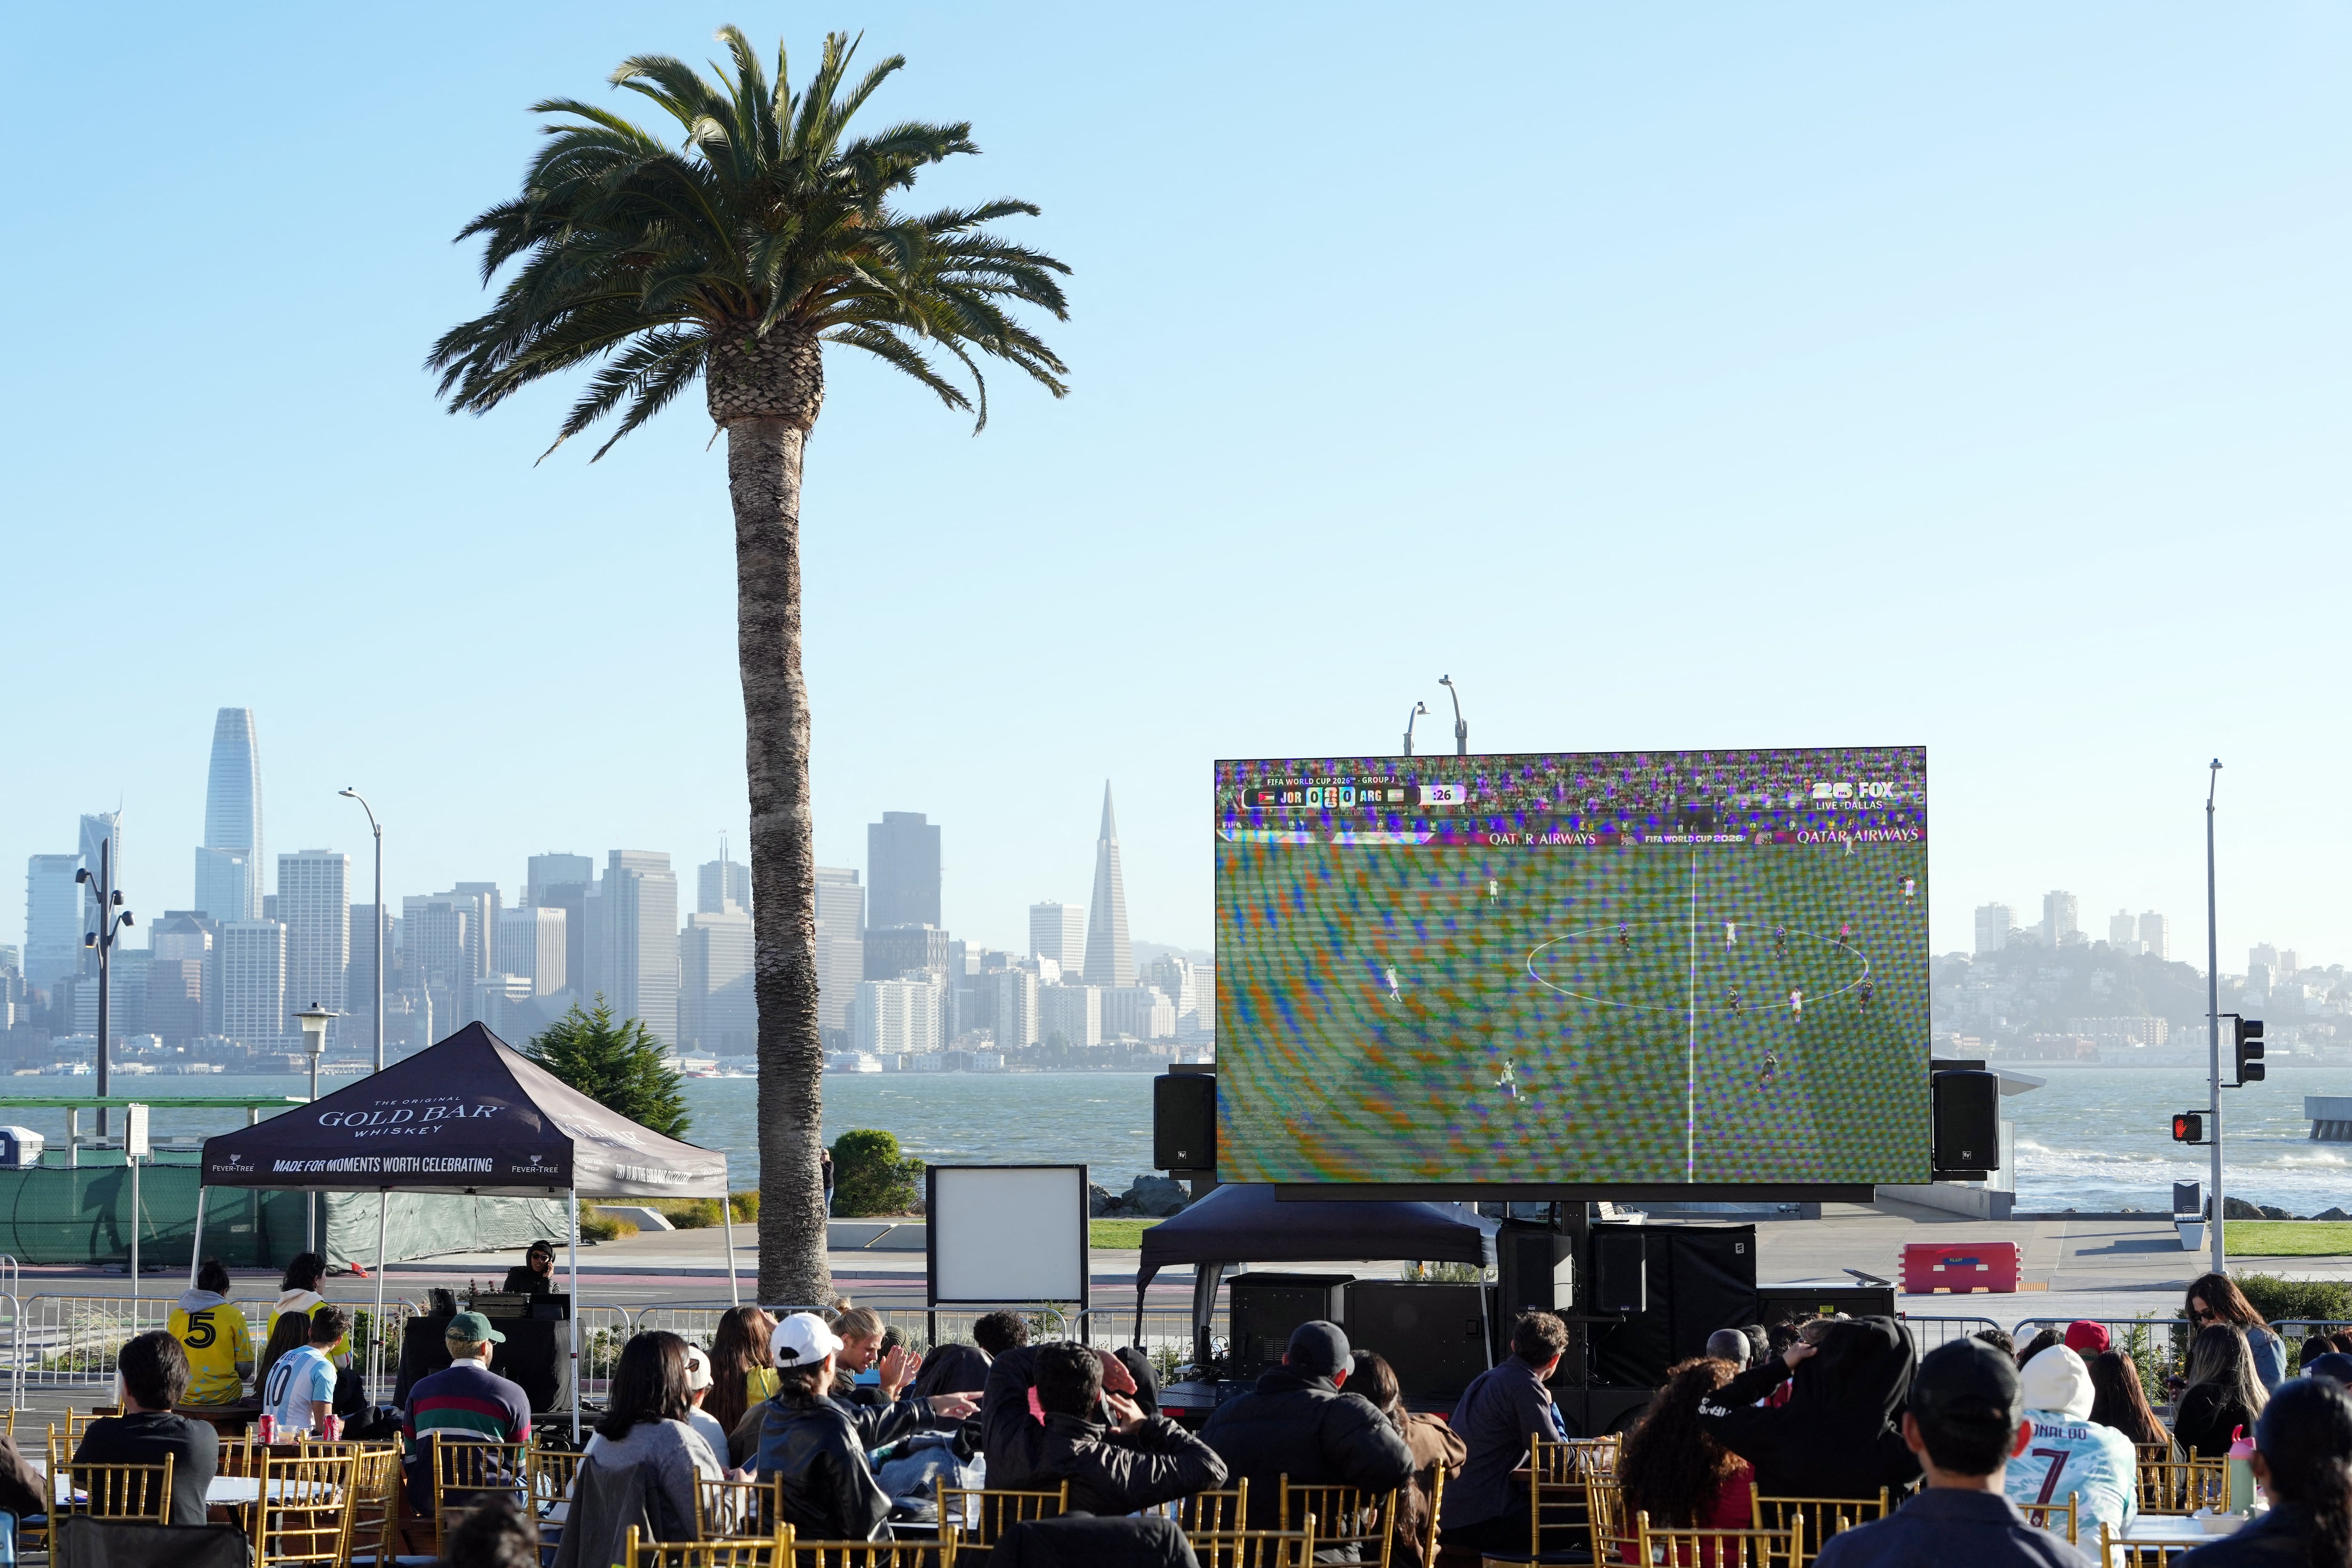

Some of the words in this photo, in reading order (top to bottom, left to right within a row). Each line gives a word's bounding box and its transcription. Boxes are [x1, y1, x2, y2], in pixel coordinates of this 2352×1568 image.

[1280, 792, 1302, 804] JOR
[1311, 791, 1319, 804] 0
[1343, 791, 1351, 804] 0
[1359, 790, 1382, 802] ARG
[1433, 790, 1451, 801] :26
[1859, 782, 1894, 798] FOX
[1816, 801, 1838, 810] LIVE
[1844, 801, 1883, 810] DALLAS
[1489, 833, 1534, 846] QATR
[1539, 833, 1596, 845] AIRWAYS
[1797, 830, 1847, 844] QATAR
[1854, 828, 1919, 843] AIRWAYS
[402, 1096, 461, 1105] ORIGINAL
[318, 1109, 413, 1127] GOLD
[355, 1124, 443, 1138] WHISKEY
[555, 1121, 609, 1137] GOLD
[272, 1159, 306, 1172] MADE
[304, 1160, 326, 1171] FOR
[326, 1157, 381, 1172] MOMENTS
[383, 1157, 420, 1172] WORTH
[422, 1157, 493, 1172] CELEBRATING
[615, 1163, 625, 1179] TRY
[626, 1165, 632, 1180] IT
[631, 1166, 638, 1181] AT
[637, 1167, 646, 1182] THE
[646, 1168, 658, 1184] GOLD
[657, 1169, 668, 1184] BAR
[184, 1312, 216, 1349] 5
[281, 1353, 300, 1362] MESSI
[266, 1362, 292, 1407] 10
[2030, 1448, 2071, 1528] 7
